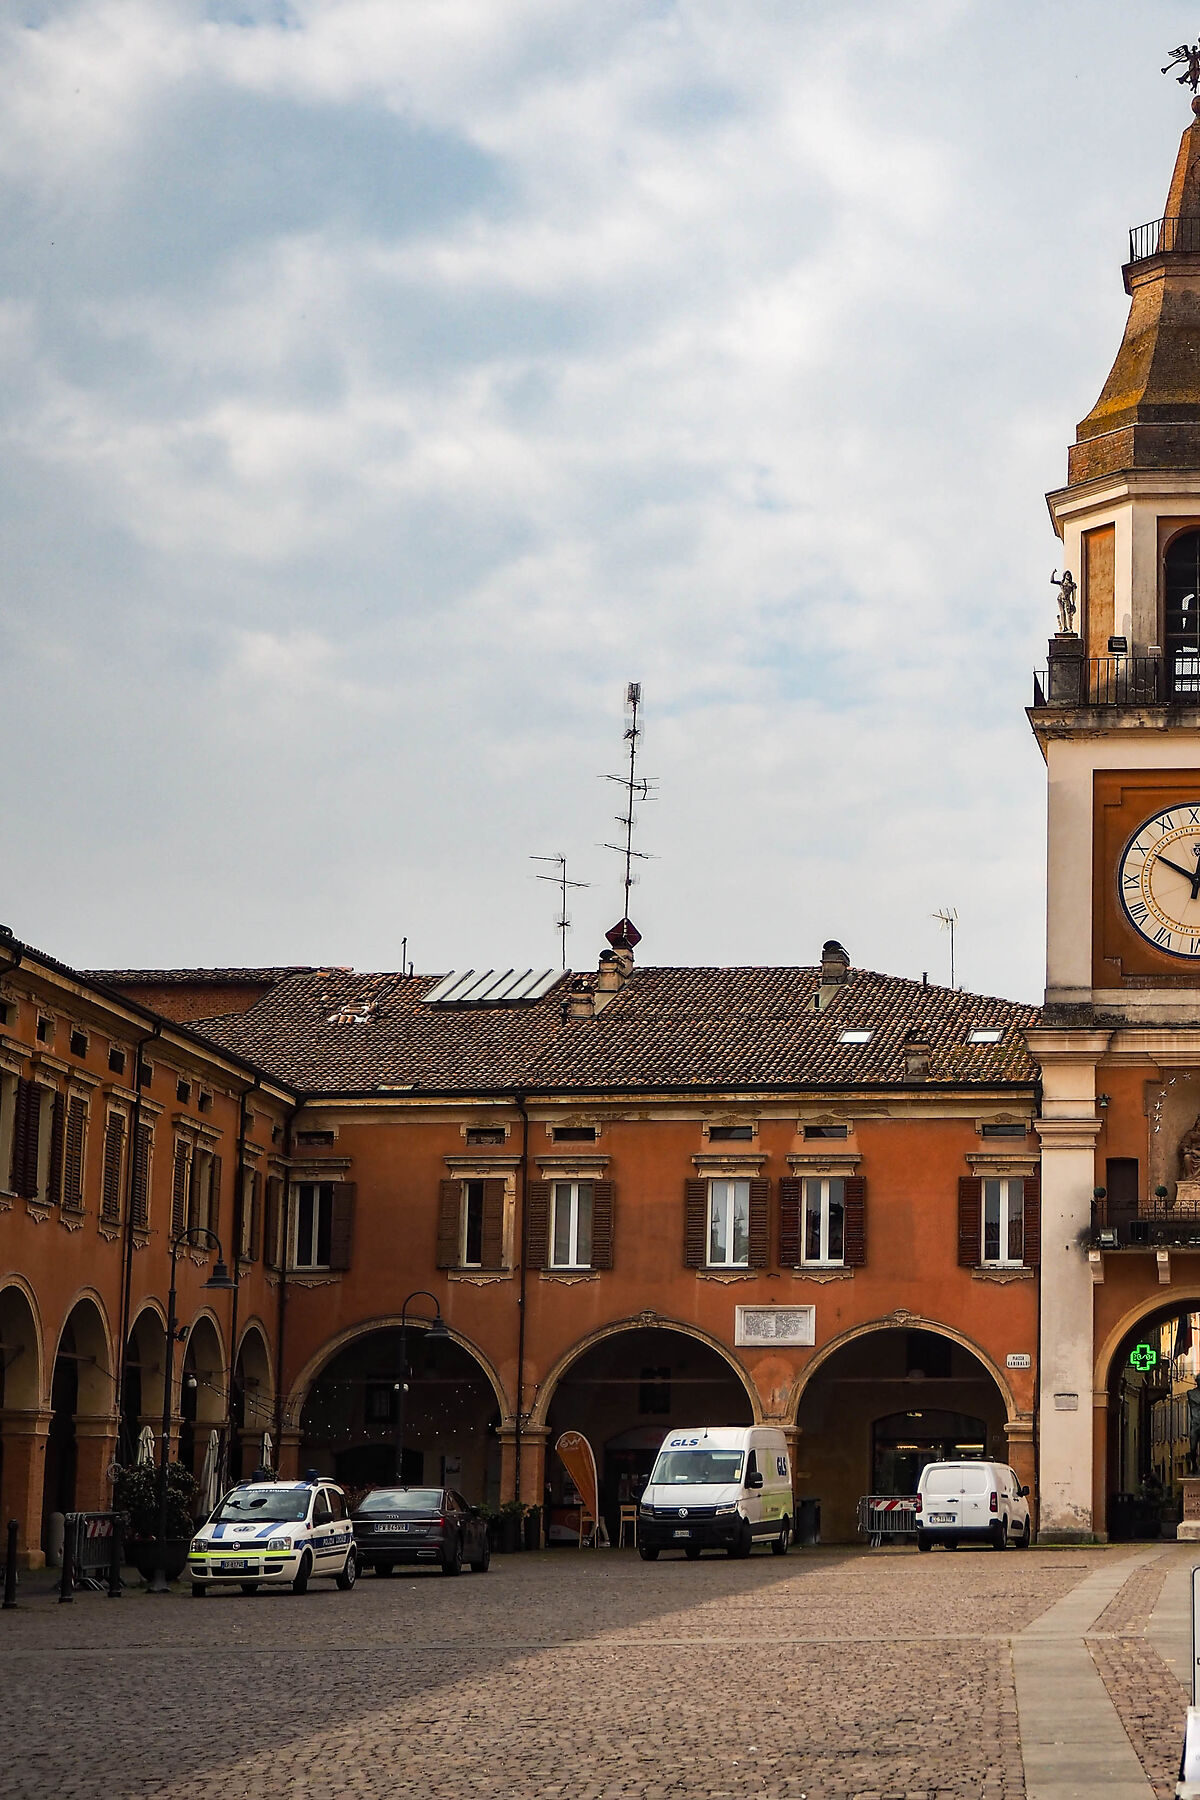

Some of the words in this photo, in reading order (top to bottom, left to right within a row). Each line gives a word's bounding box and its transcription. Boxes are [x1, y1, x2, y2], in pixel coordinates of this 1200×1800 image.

[1155, 814, 1175, 835] XI
[1132, 841, 1150, 857] X
[1123, 874, 1140, 889] IX
[1128, 901, 1150, 926] VIII
[1153, 926, 1172, 948] VII
[670, 1438, 700, 1447] GLS
[777, 1456, 787, 1476] GLS
